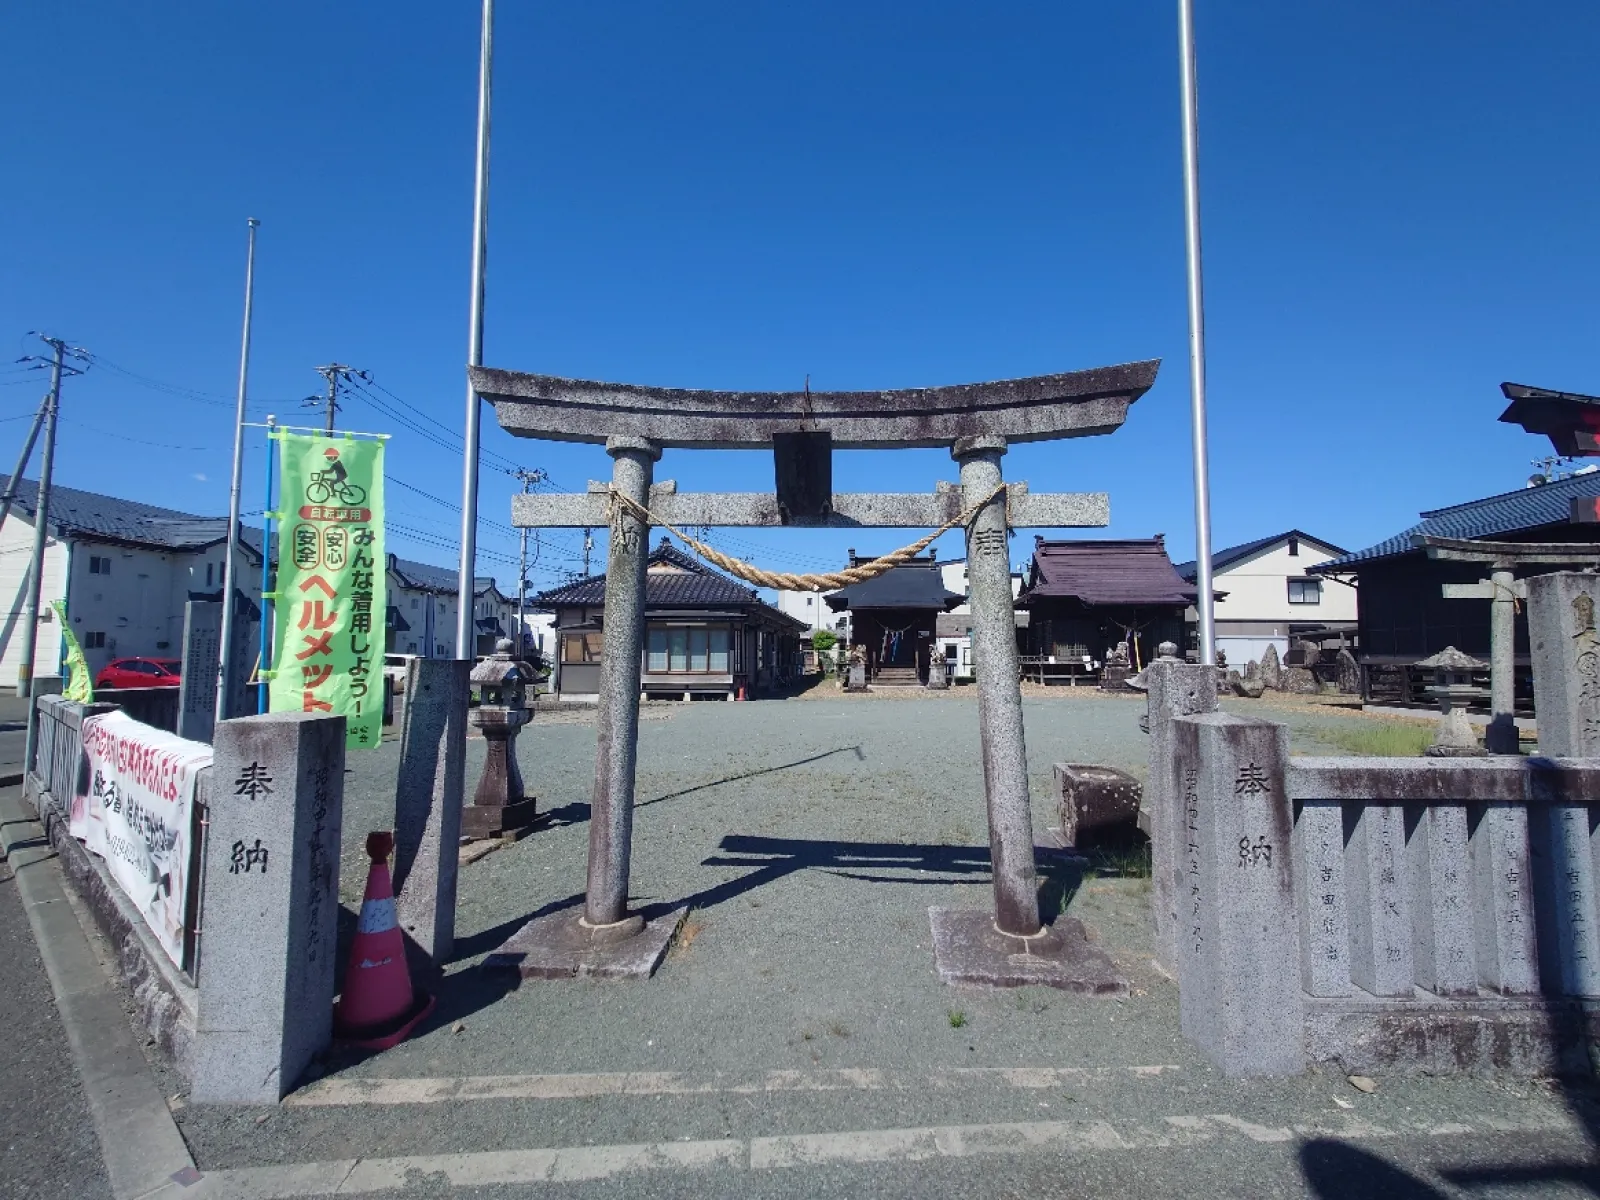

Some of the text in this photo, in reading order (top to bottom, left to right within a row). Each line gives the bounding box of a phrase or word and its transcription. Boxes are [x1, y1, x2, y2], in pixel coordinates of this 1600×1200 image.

[310, 507, 361, 521] 自転車用
[296, 530, 317, 564] 安全
[325, 532, 343, 565] 安心
[975, 527, 1004, 557] 奉
[295, 575, 338, 713] ヘルメット
